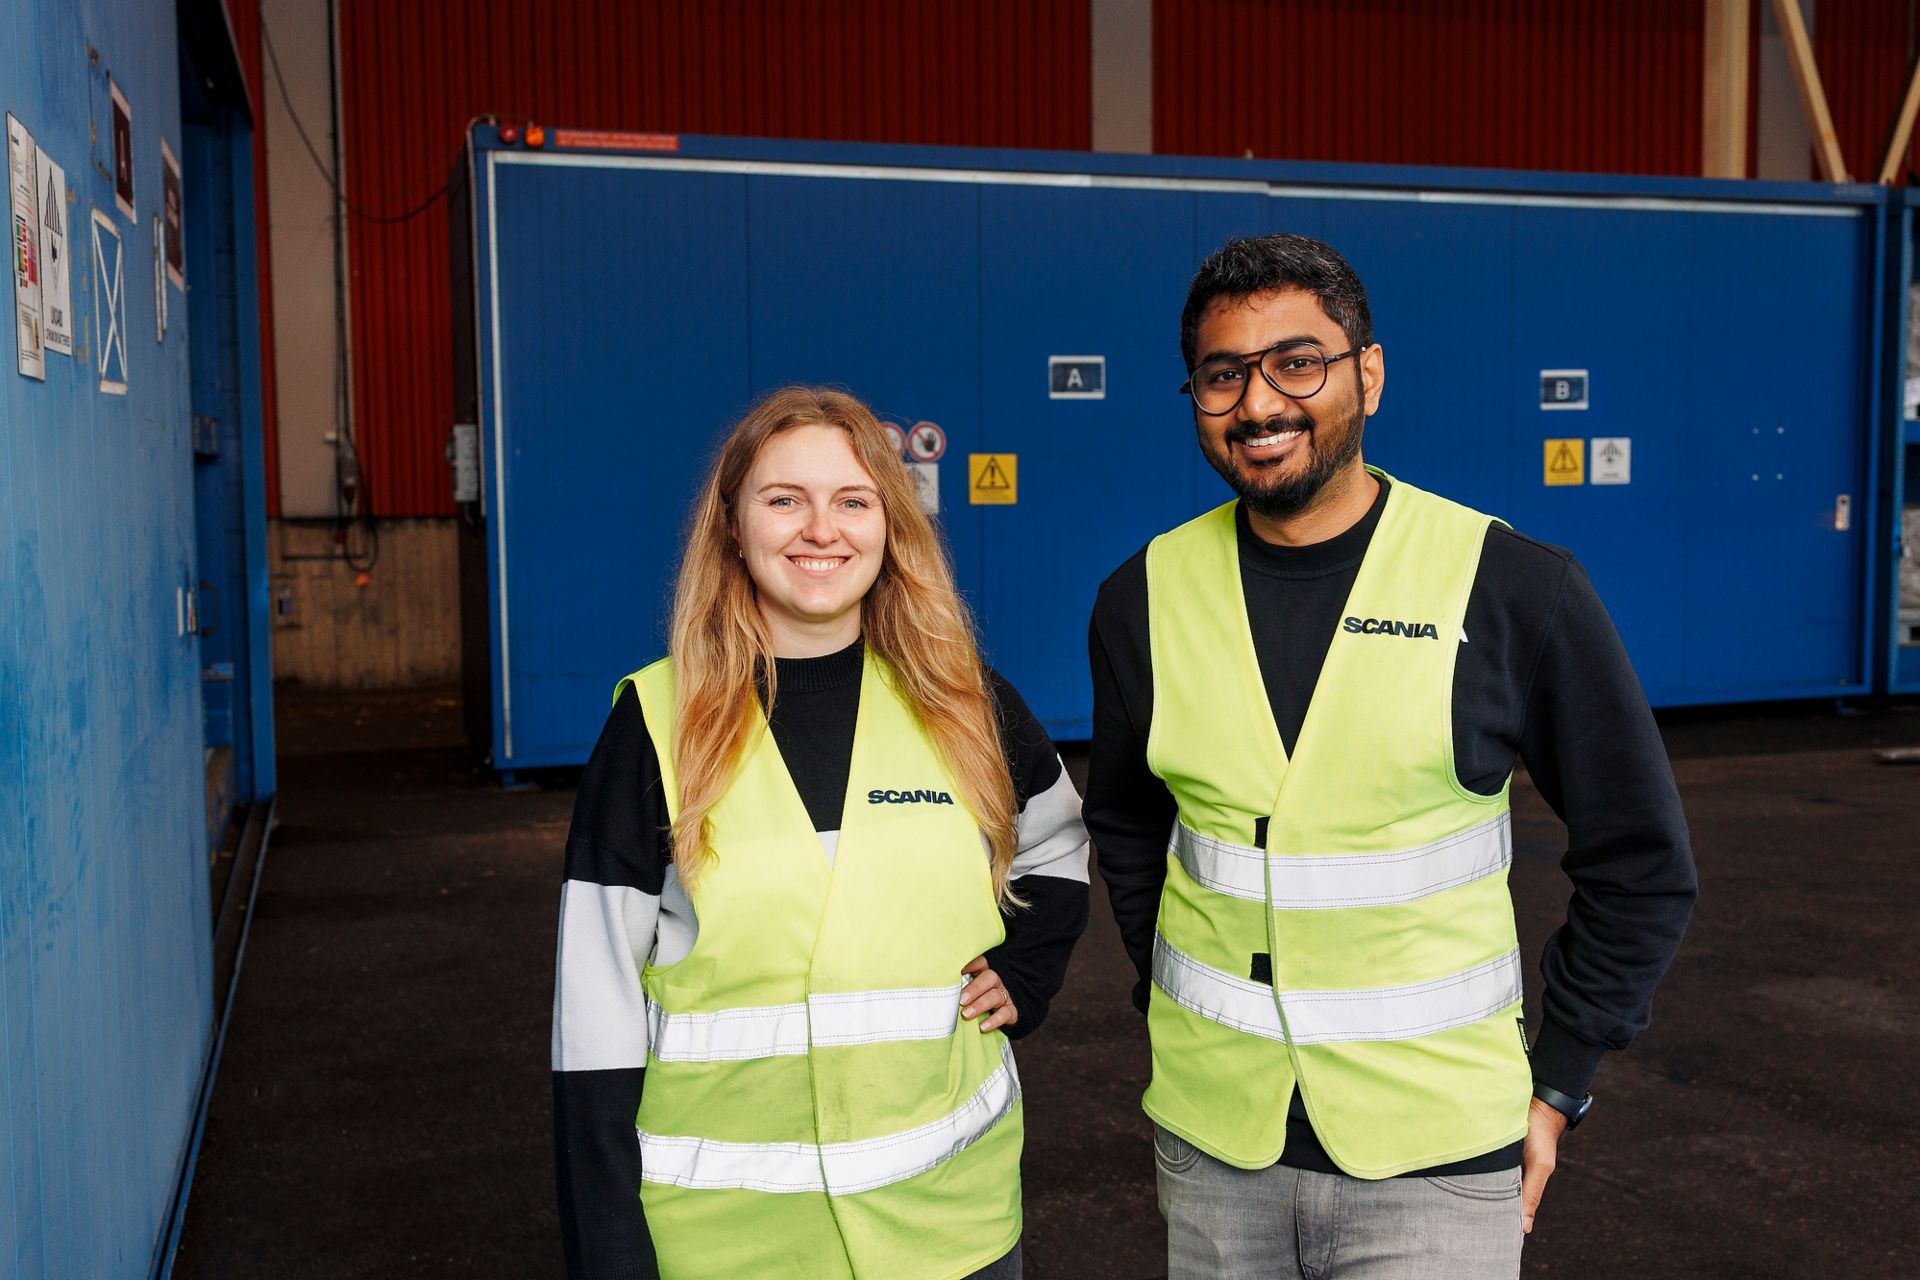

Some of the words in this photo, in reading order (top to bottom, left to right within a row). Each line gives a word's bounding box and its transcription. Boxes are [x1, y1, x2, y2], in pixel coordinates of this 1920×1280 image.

[1067, 367, 1083, 387] A
[1555, 380, 1570, 400] B
[1343, 616, 1439, 640] SCANIA
[868, 789, 954, 805] SCANIA
